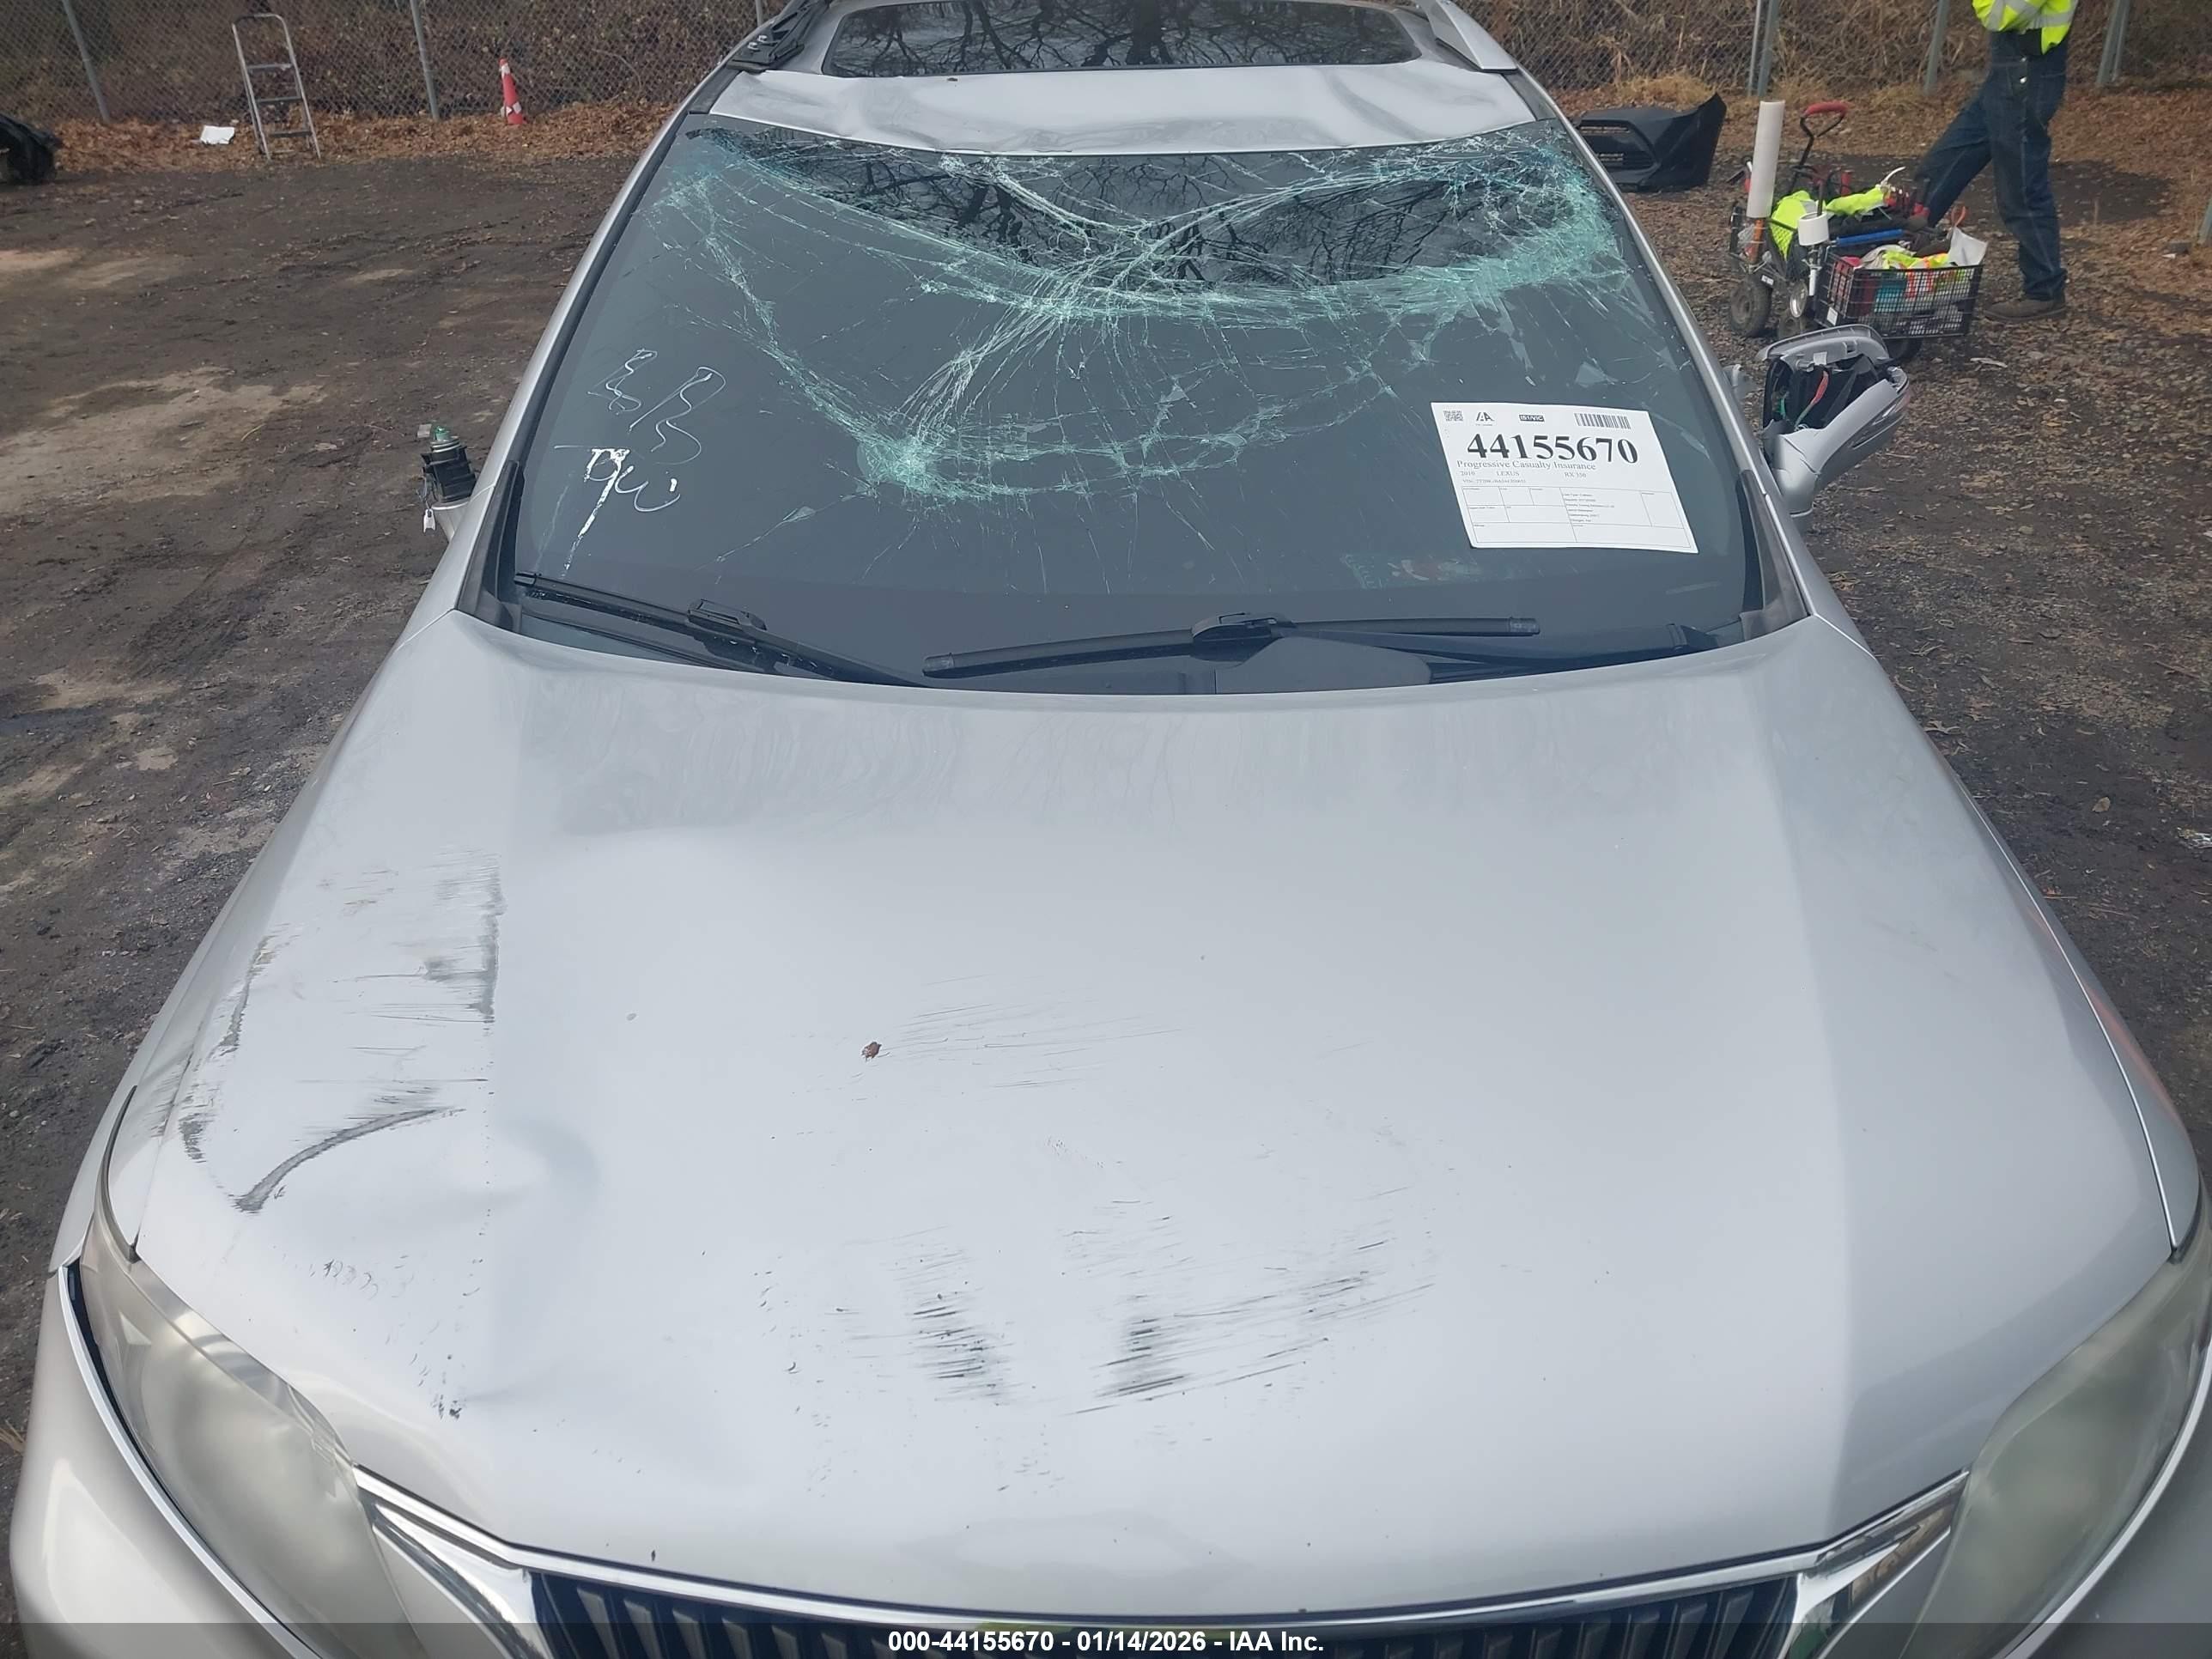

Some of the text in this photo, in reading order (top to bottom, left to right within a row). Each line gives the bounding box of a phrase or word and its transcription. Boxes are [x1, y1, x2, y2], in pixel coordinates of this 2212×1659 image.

[1467, 433, 1638, 465] 44155670
[1456, 459, 1596, 471] Progressive Casualty Insurance
